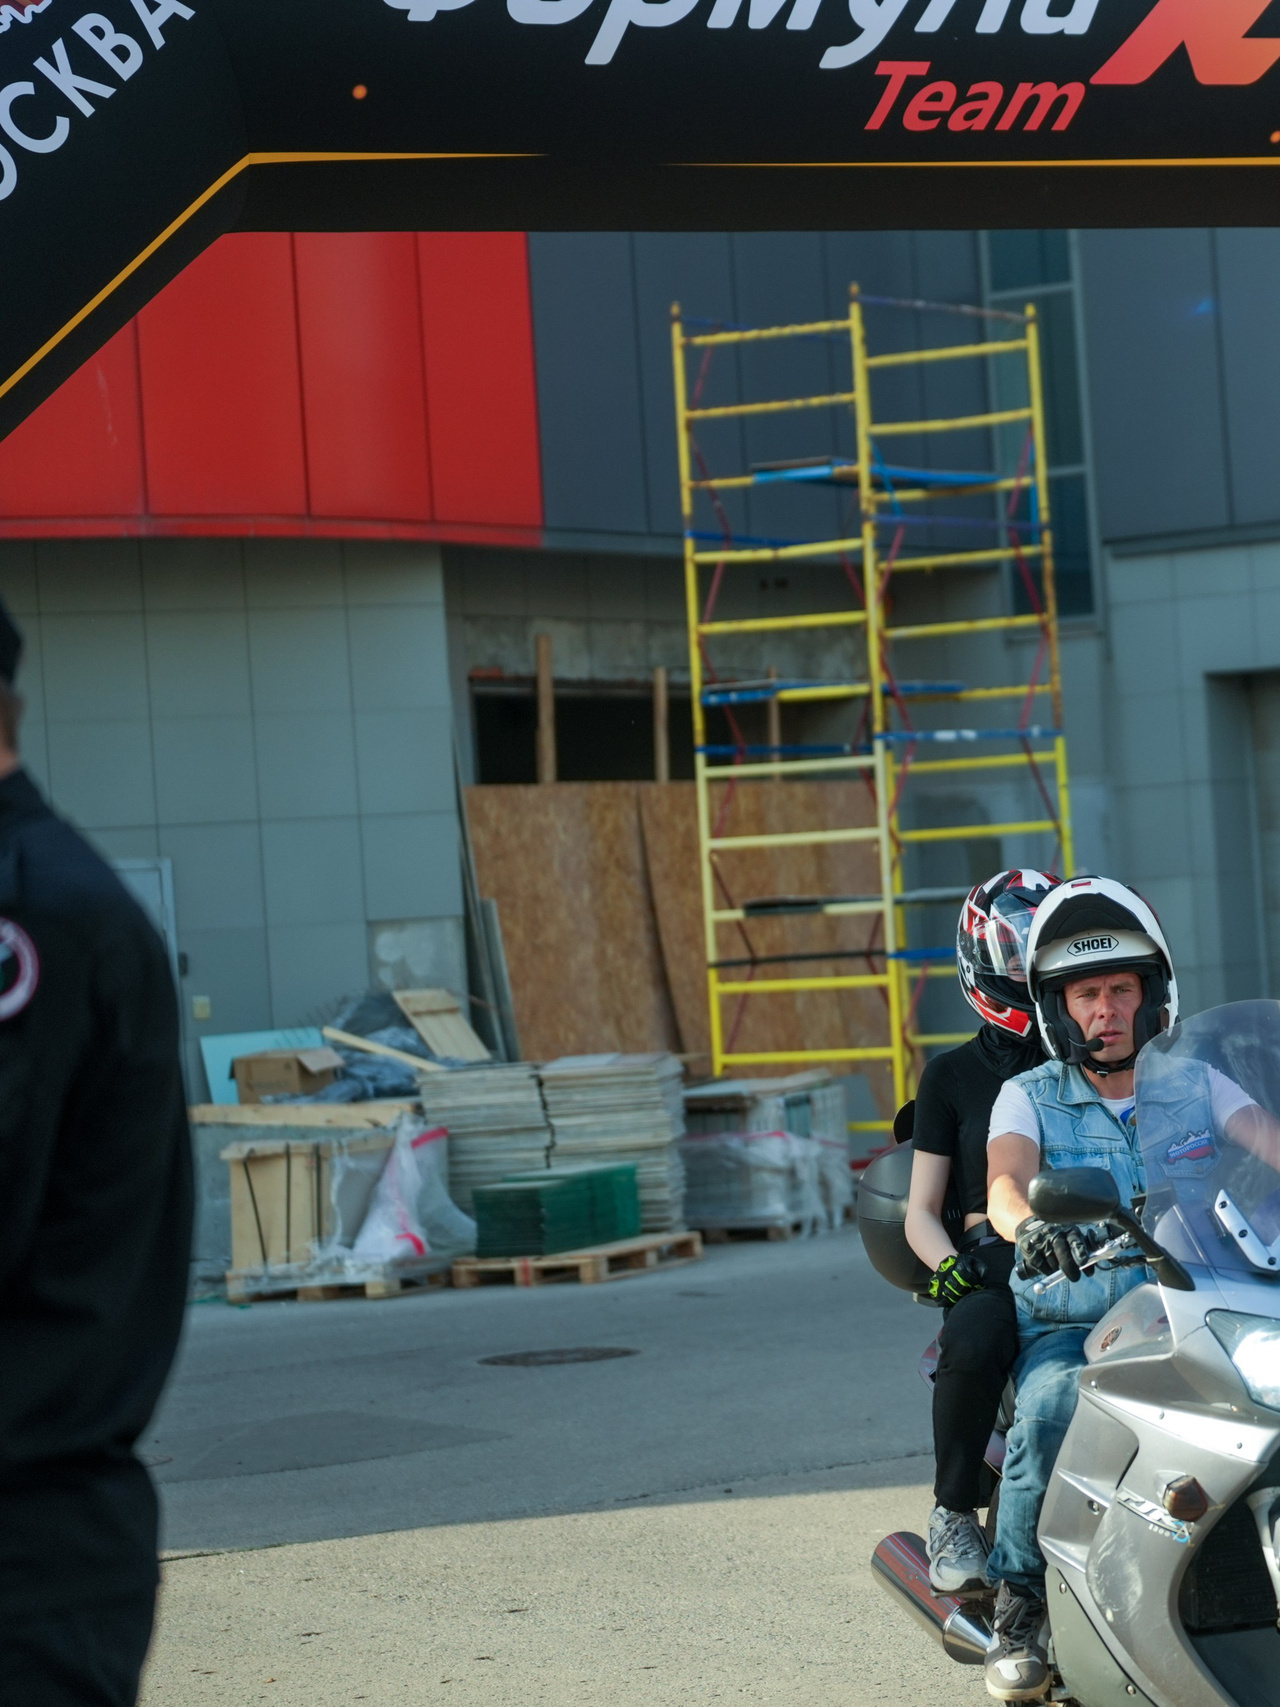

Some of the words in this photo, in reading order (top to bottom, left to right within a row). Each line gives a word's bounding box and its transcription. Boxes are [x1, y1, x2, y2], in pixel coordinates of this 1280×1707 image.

[863, 60, 1087, 132] Team
[1073, 937, 1112, 954] SHOEI
[1168, 1139, 1208, 1158] МОТОРОССИЯ
